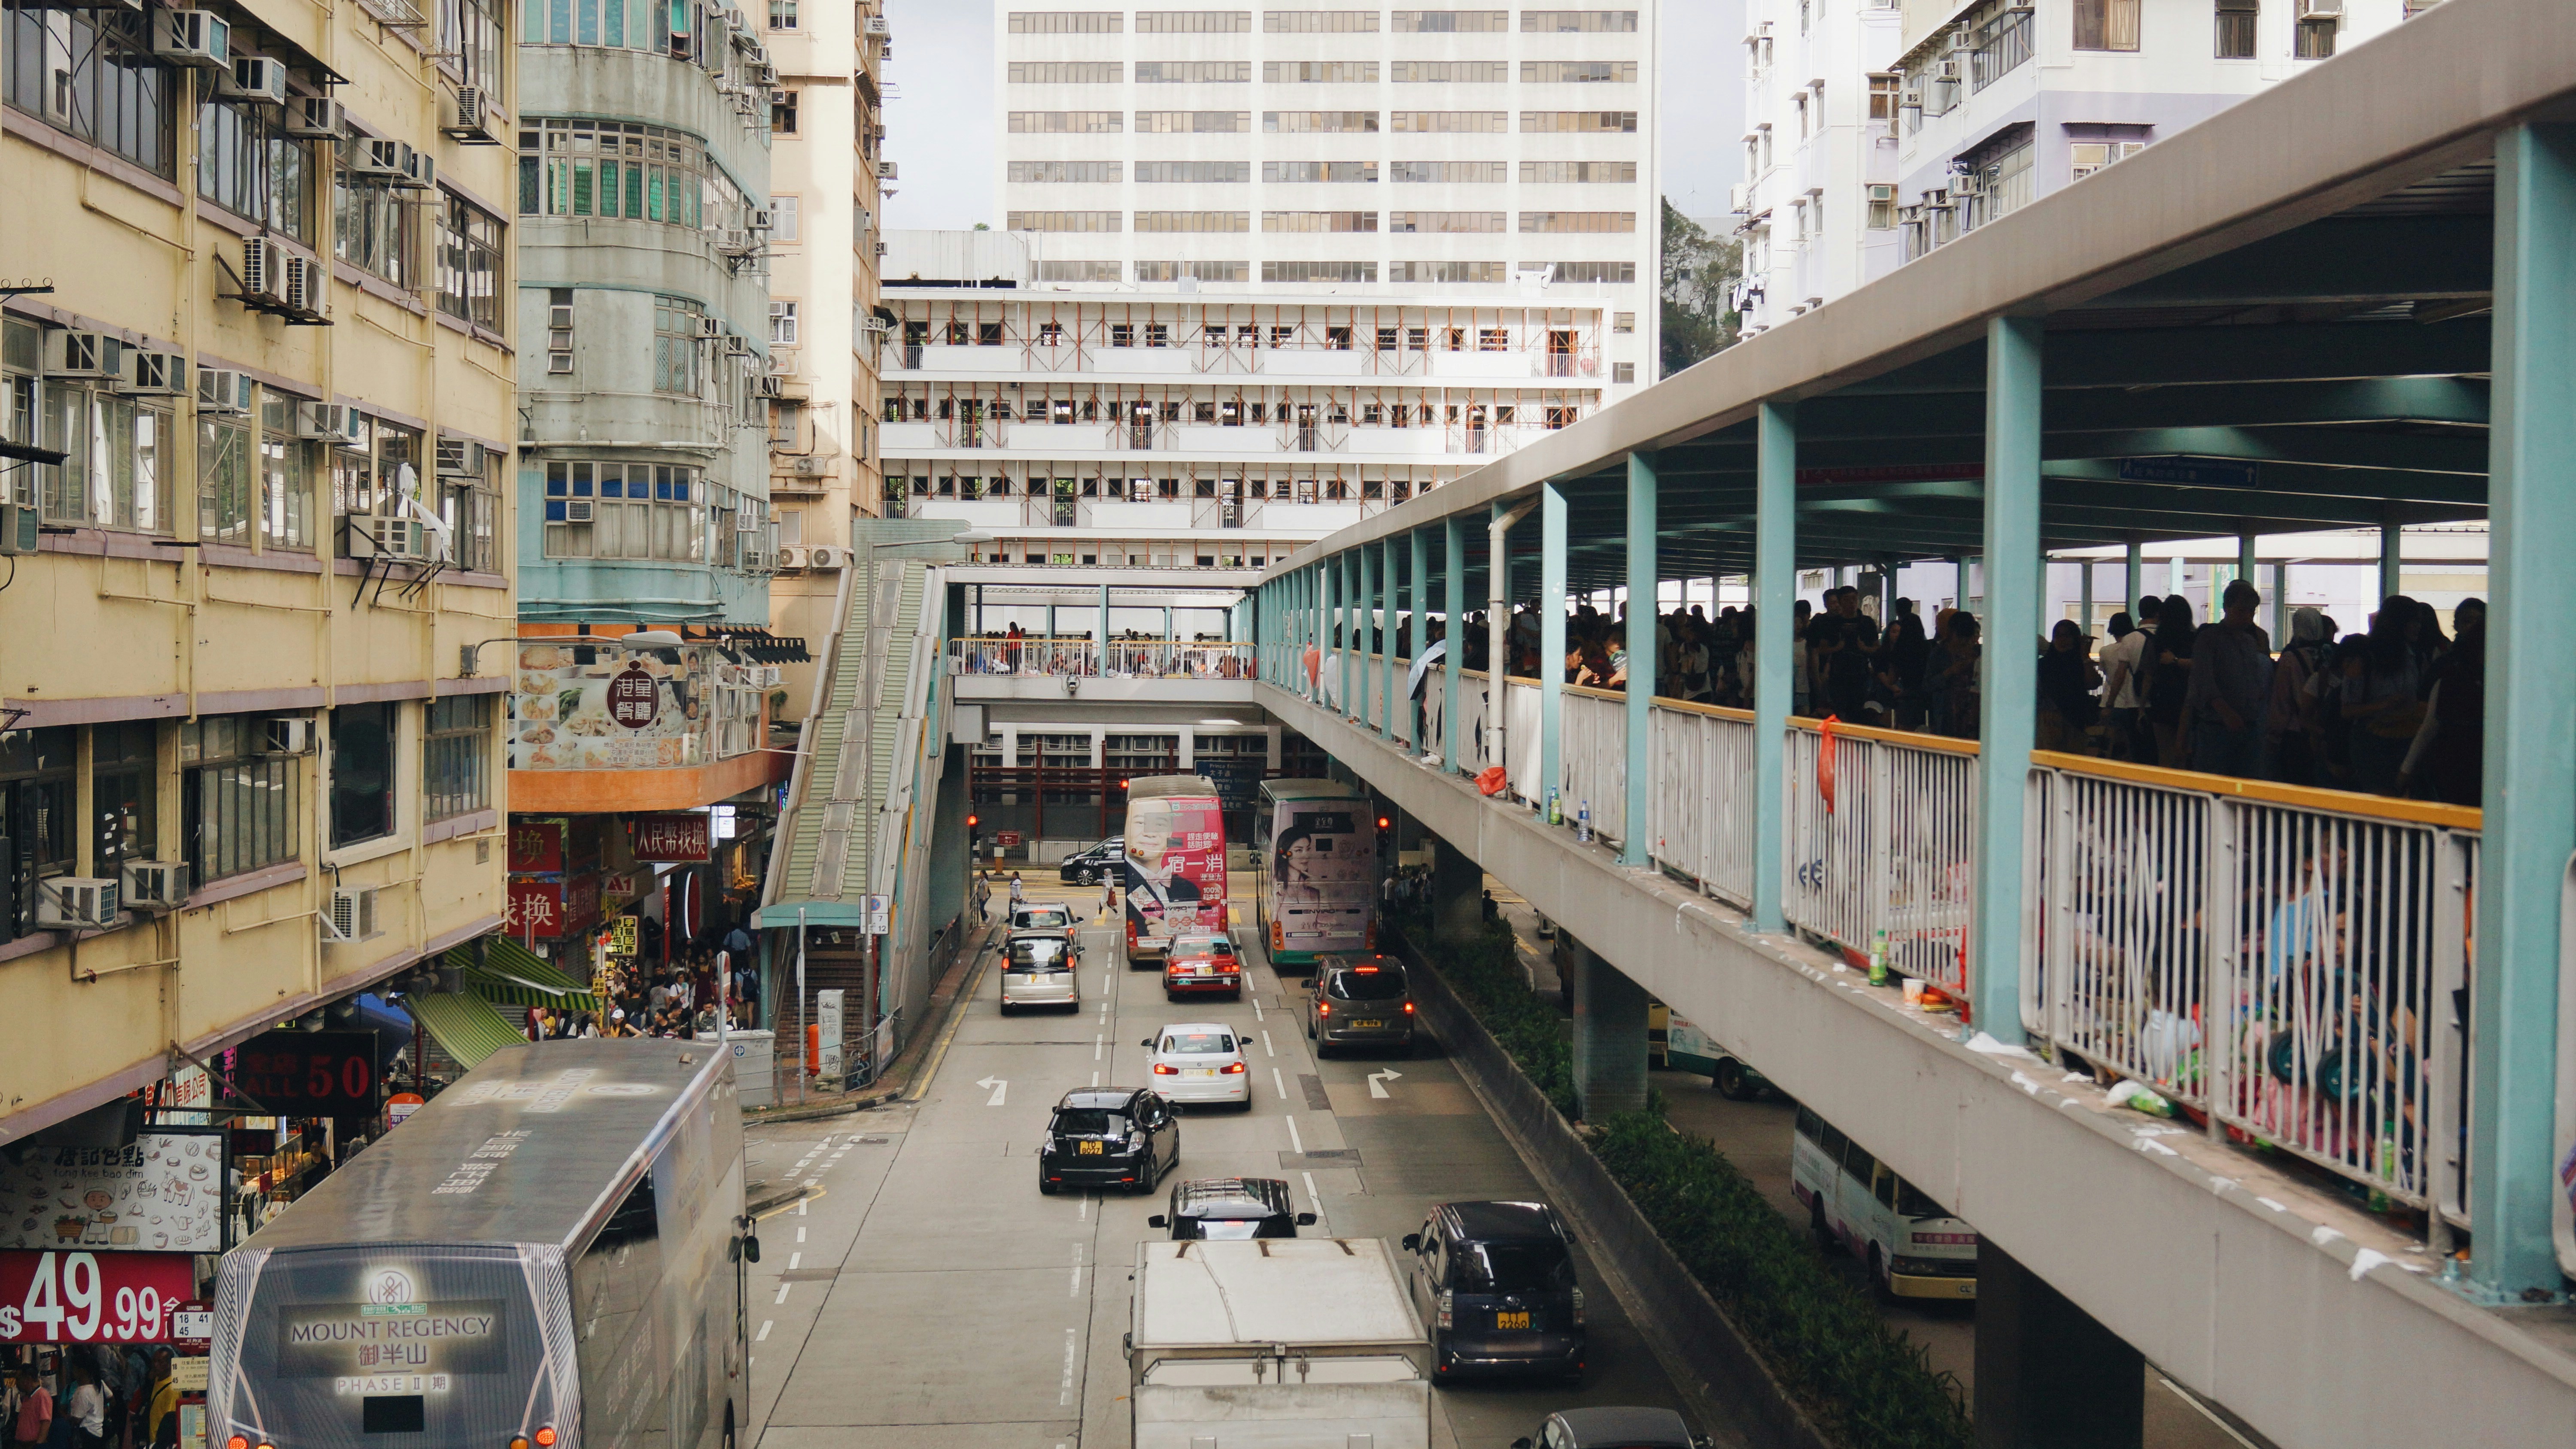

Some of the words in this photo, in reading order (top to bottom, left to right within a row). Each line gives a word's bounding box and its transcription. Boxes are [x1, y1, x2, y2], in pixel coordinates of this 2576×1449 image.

[243, 1076, 298, 1097] ALL
[307, 1055, 369, 1098] 50
[54, 1169, 77, 1179] tong
[82, 1169, 100, 1179] kee
[103, 1169, 122, 1179] bao
[126, 1169, 144, 1178] dim
[0, 1252, 161, 1340] $49.99
[179, 1314, 189, 1323] 18
[199, 1313, 208, 1323] 41
[179, 1326, 189, 1336] 45
[292, 1322, 380, 1342] MOUNT
[387, 1317, 491, 1338] REGENCY
[358, 1342, 427, 1367] 御半山
[337, 1377, 401, 1392] PHASE
[432, 1375, 446, 1390] 期
